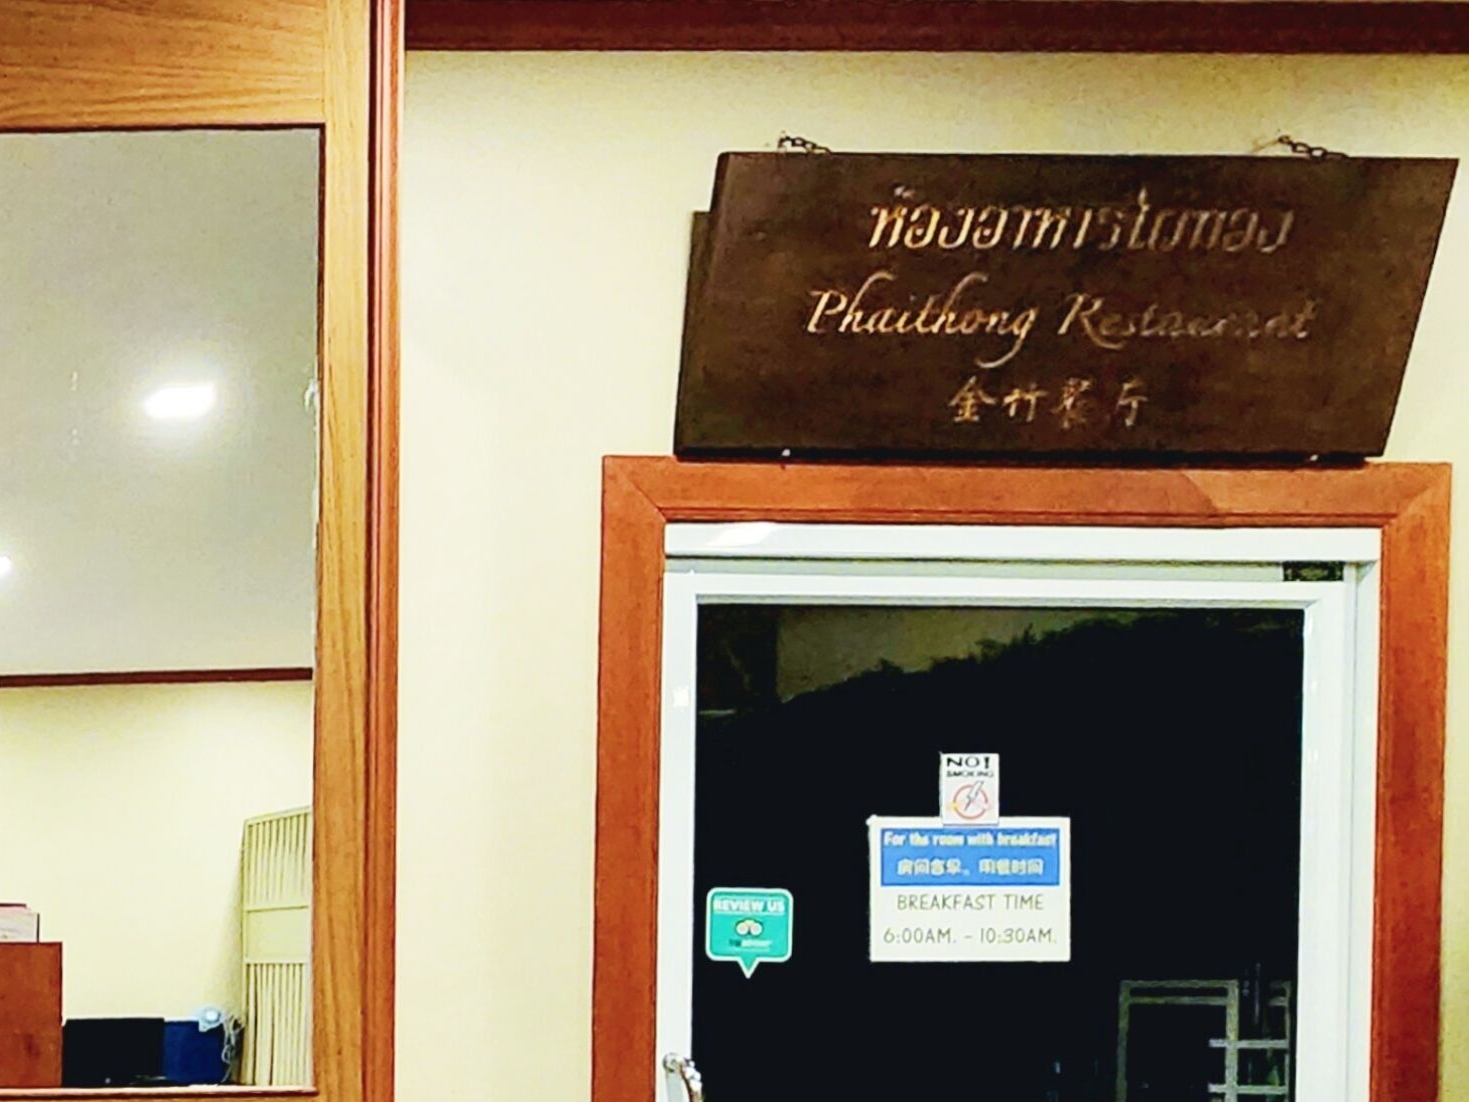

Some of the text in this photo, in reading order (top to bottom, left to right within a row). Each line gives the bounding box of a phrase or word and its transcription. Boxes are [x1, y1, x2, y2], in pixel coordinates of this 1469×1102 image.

[805, 271, 1039, 368] Phaithong
[946, 756, 990, 769] NO!
[883, 832, 906, 846] For
[909, 832, 930, 846] the
[967, 832, 995, 846] with
[997, 832, 1057, 847] breakfast
[713, 898, 785, 914] REVIEW US
[897, 894, 1044, 911] BREAKFAST TIME
